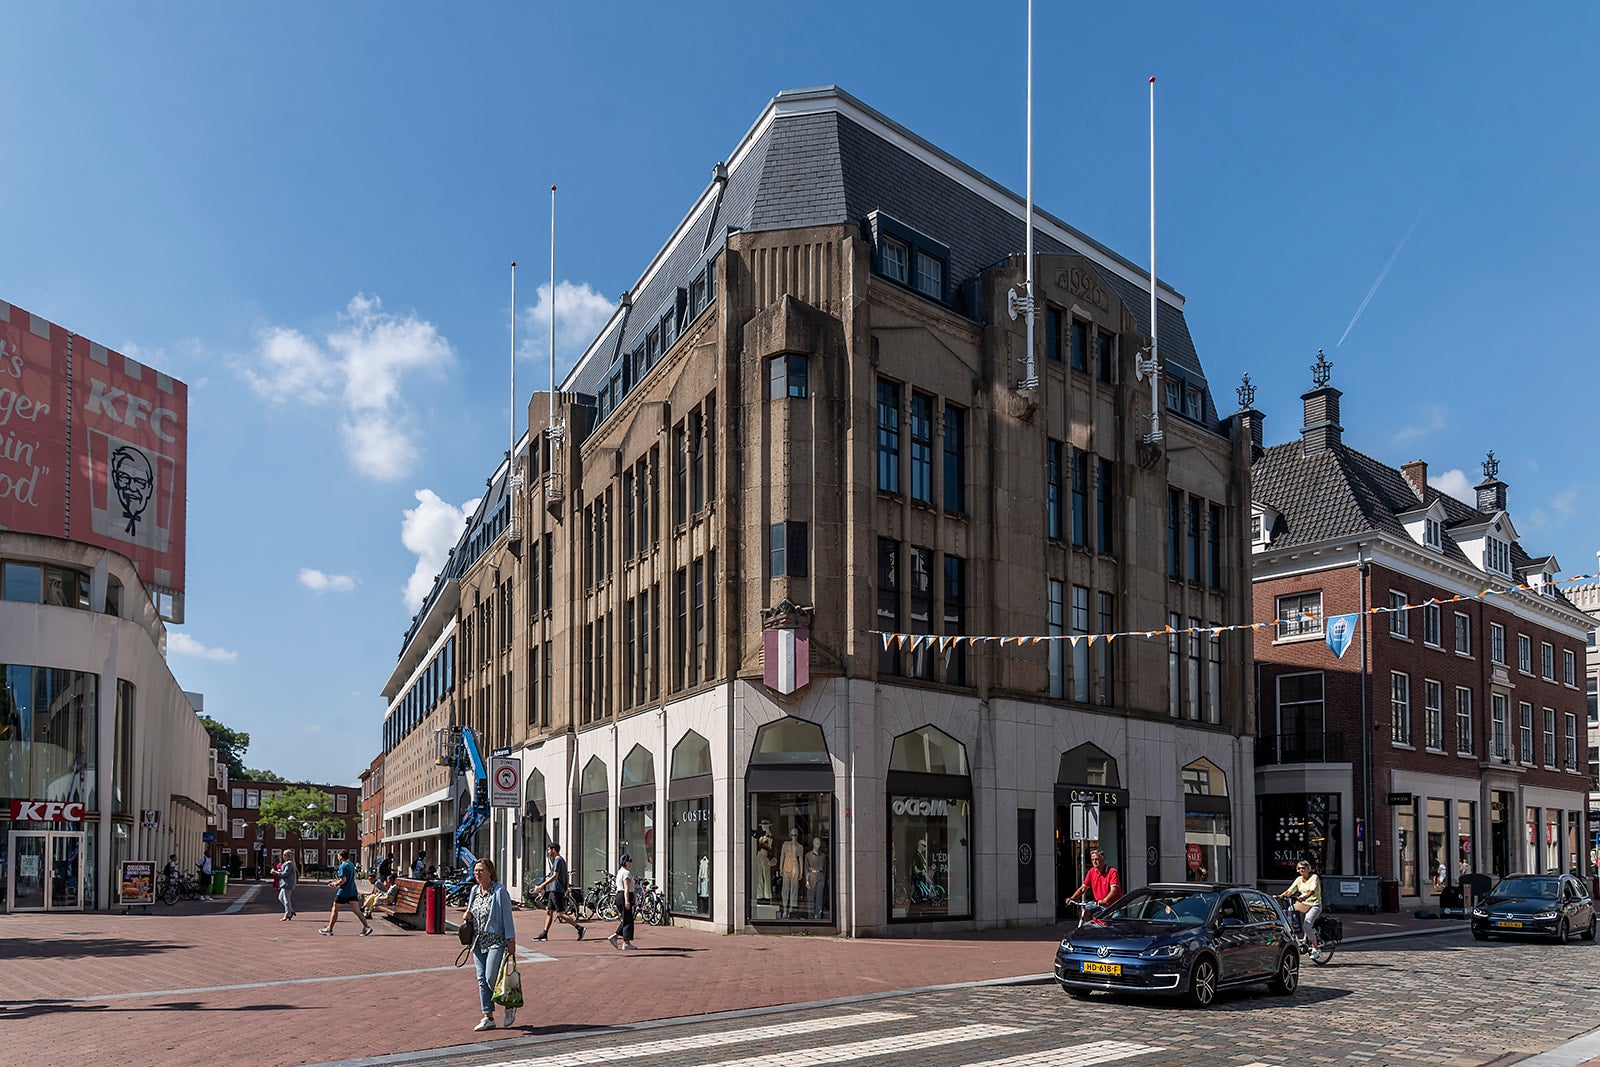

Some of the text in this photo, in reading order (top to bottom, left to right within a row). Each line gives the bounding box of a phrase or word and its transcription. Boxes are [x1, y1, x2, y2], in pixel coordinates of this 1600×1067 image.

[84, 376, 178, 443] KFC
[1070, 790, 1118, 805] CTES
[16, 801, 83, 822] KFC
[1274, 850, 1303, 861] SALE
